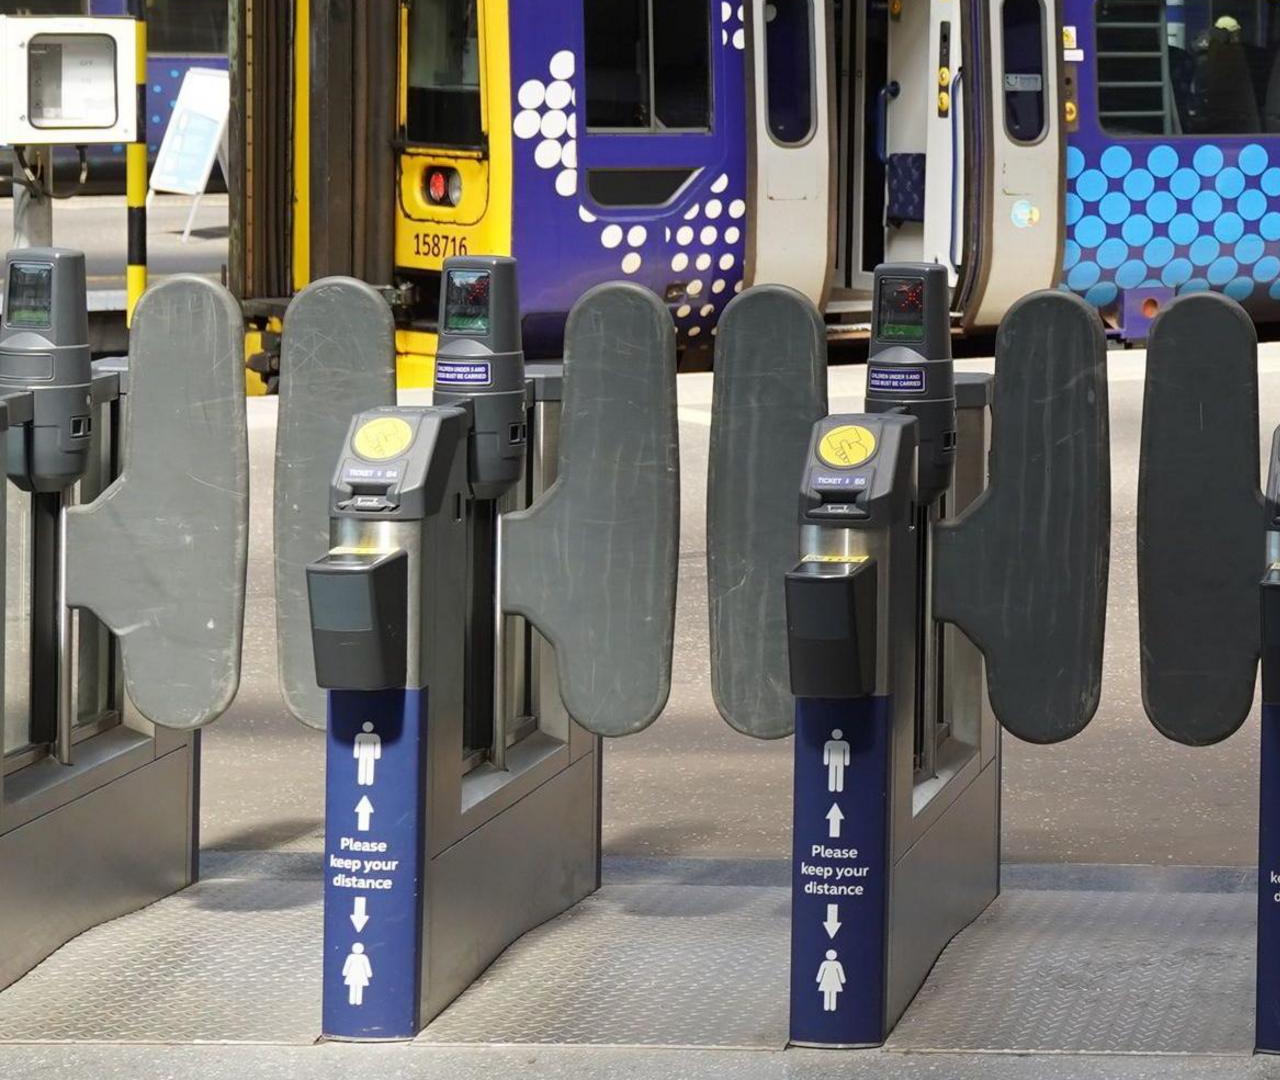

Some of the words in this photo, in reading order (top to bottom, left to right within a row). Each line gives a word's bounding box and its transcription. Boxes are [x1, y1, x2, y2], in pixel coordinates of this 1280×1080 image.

[414, 233, 468, 257] 158716
[349, 469, 374, 477] TICKET
[341, 837, 387, 852] Please
[812, 845, 858, 859] Please
[330, 854, 361, 872] keep
[364, 860, 399, 873] your
[802, 862, 833, 879] keep
[836, 866, 869, 879] your
[333, 874, 393, 889] distance
[805, 881, 864, 896] distance
